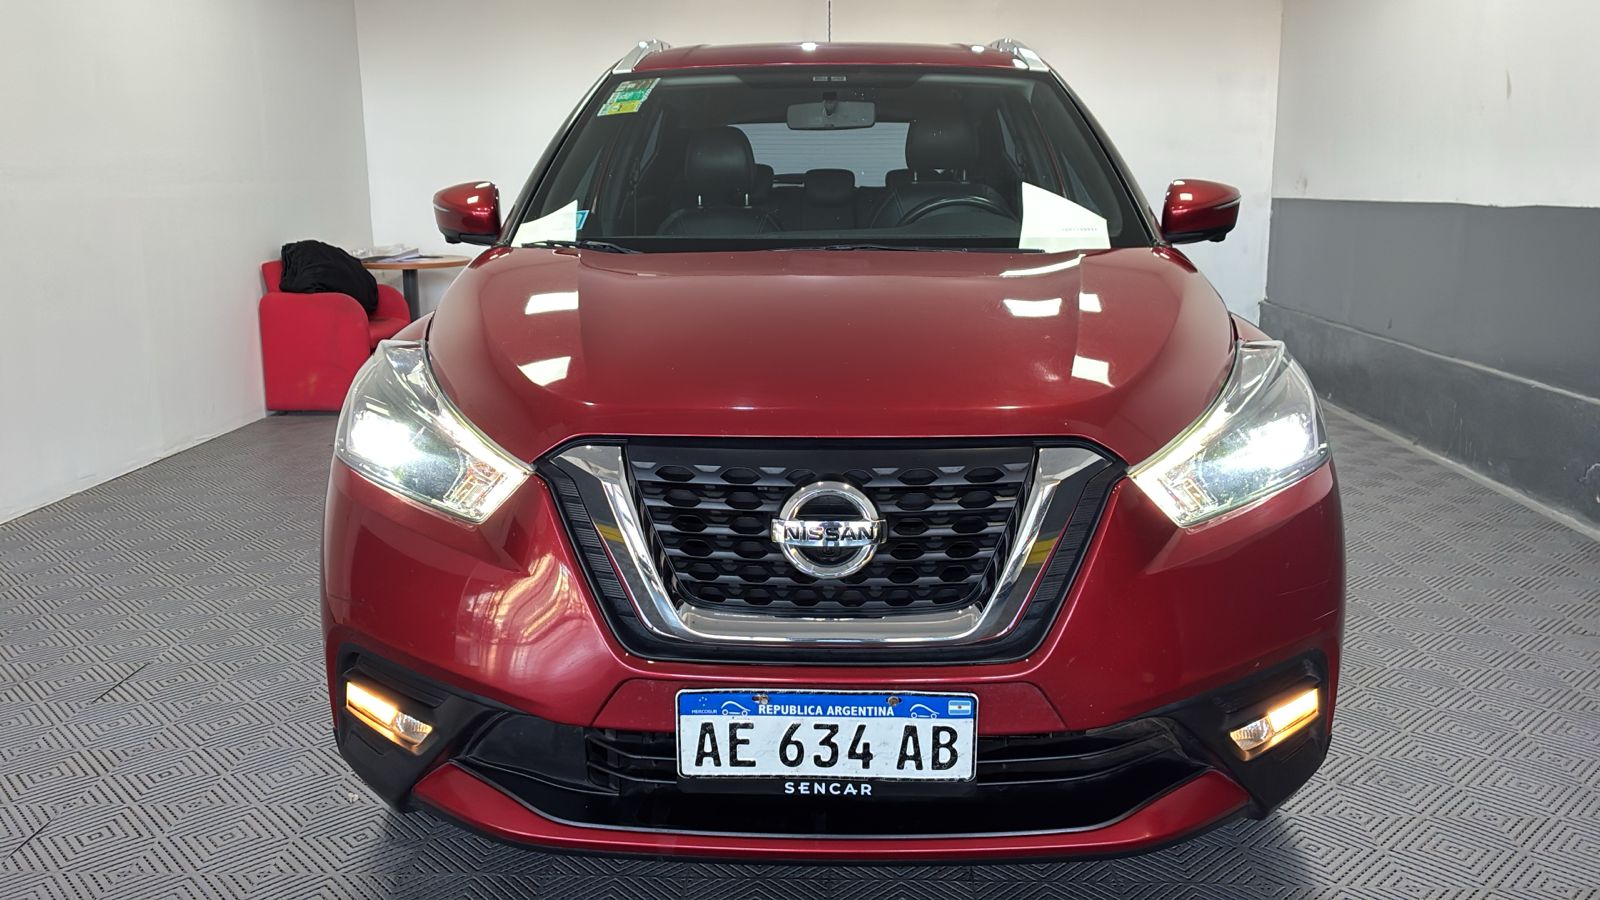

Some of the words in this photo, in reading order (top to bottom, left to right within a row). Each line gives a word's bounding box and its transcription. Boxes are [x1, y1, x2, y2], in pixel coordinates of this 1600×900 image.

[784, 526, 874, 541] NISSAN
[758, 704, 823, 716] REPUBLICA
[826, 705, 895, 717] ARGENTINA
[694, 722, 756, 767] AE
[778, 722, 874, 769] 634
[896, 724, 959, 771] AB
[784, 782, 872, 796] SENCAR
